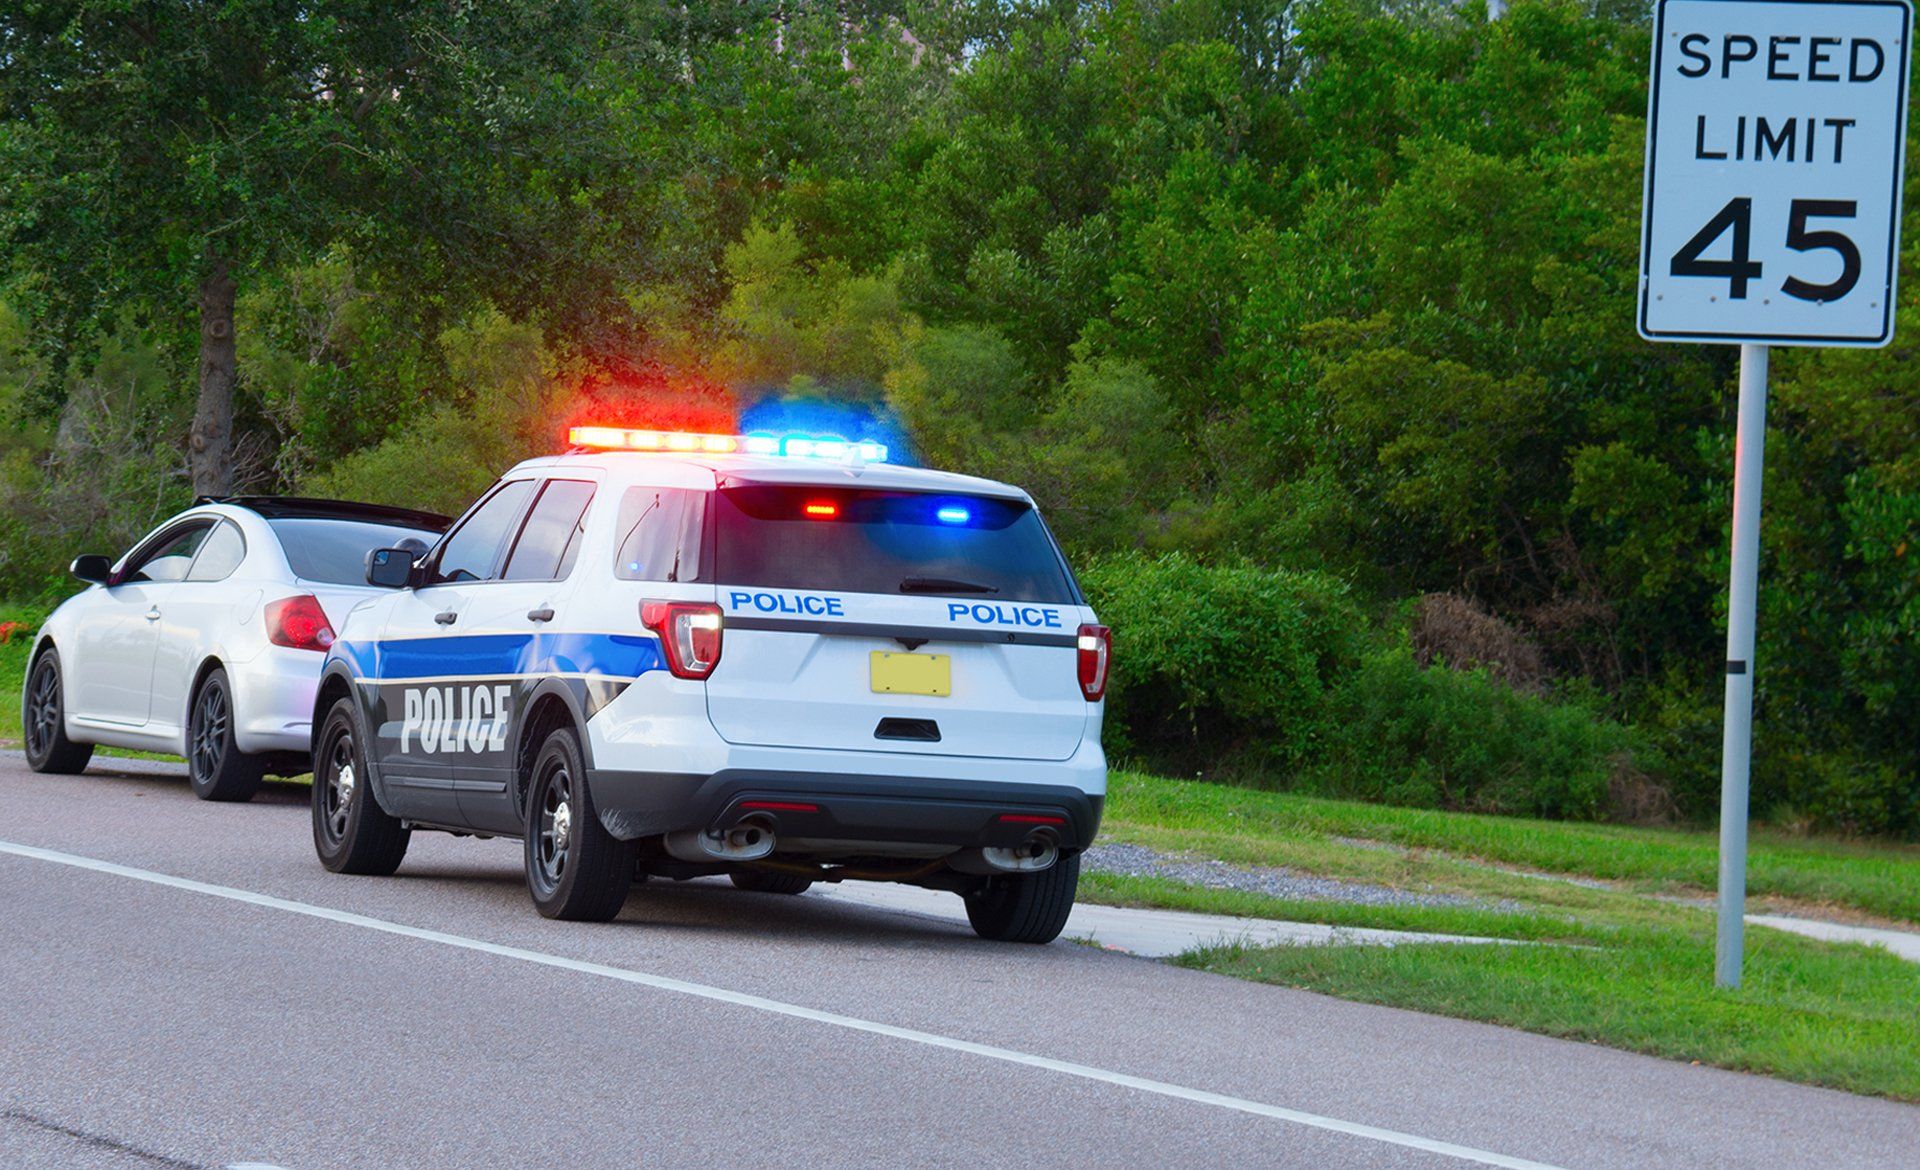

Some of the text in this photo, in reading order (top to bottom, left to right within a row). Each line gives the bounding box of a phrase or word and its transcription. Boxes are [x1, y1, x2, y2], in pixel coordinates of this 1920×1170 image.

[1677, 33, 1885, 83] SPEED
[1695, 115, 1856, 163] LIMIT
[1670, 197, 1862, 303] 45
[730, 592, 845, 616] POLICE
[947, 603, 1062, 628] POLICE
[401, 684, 511, 754] POLICE
